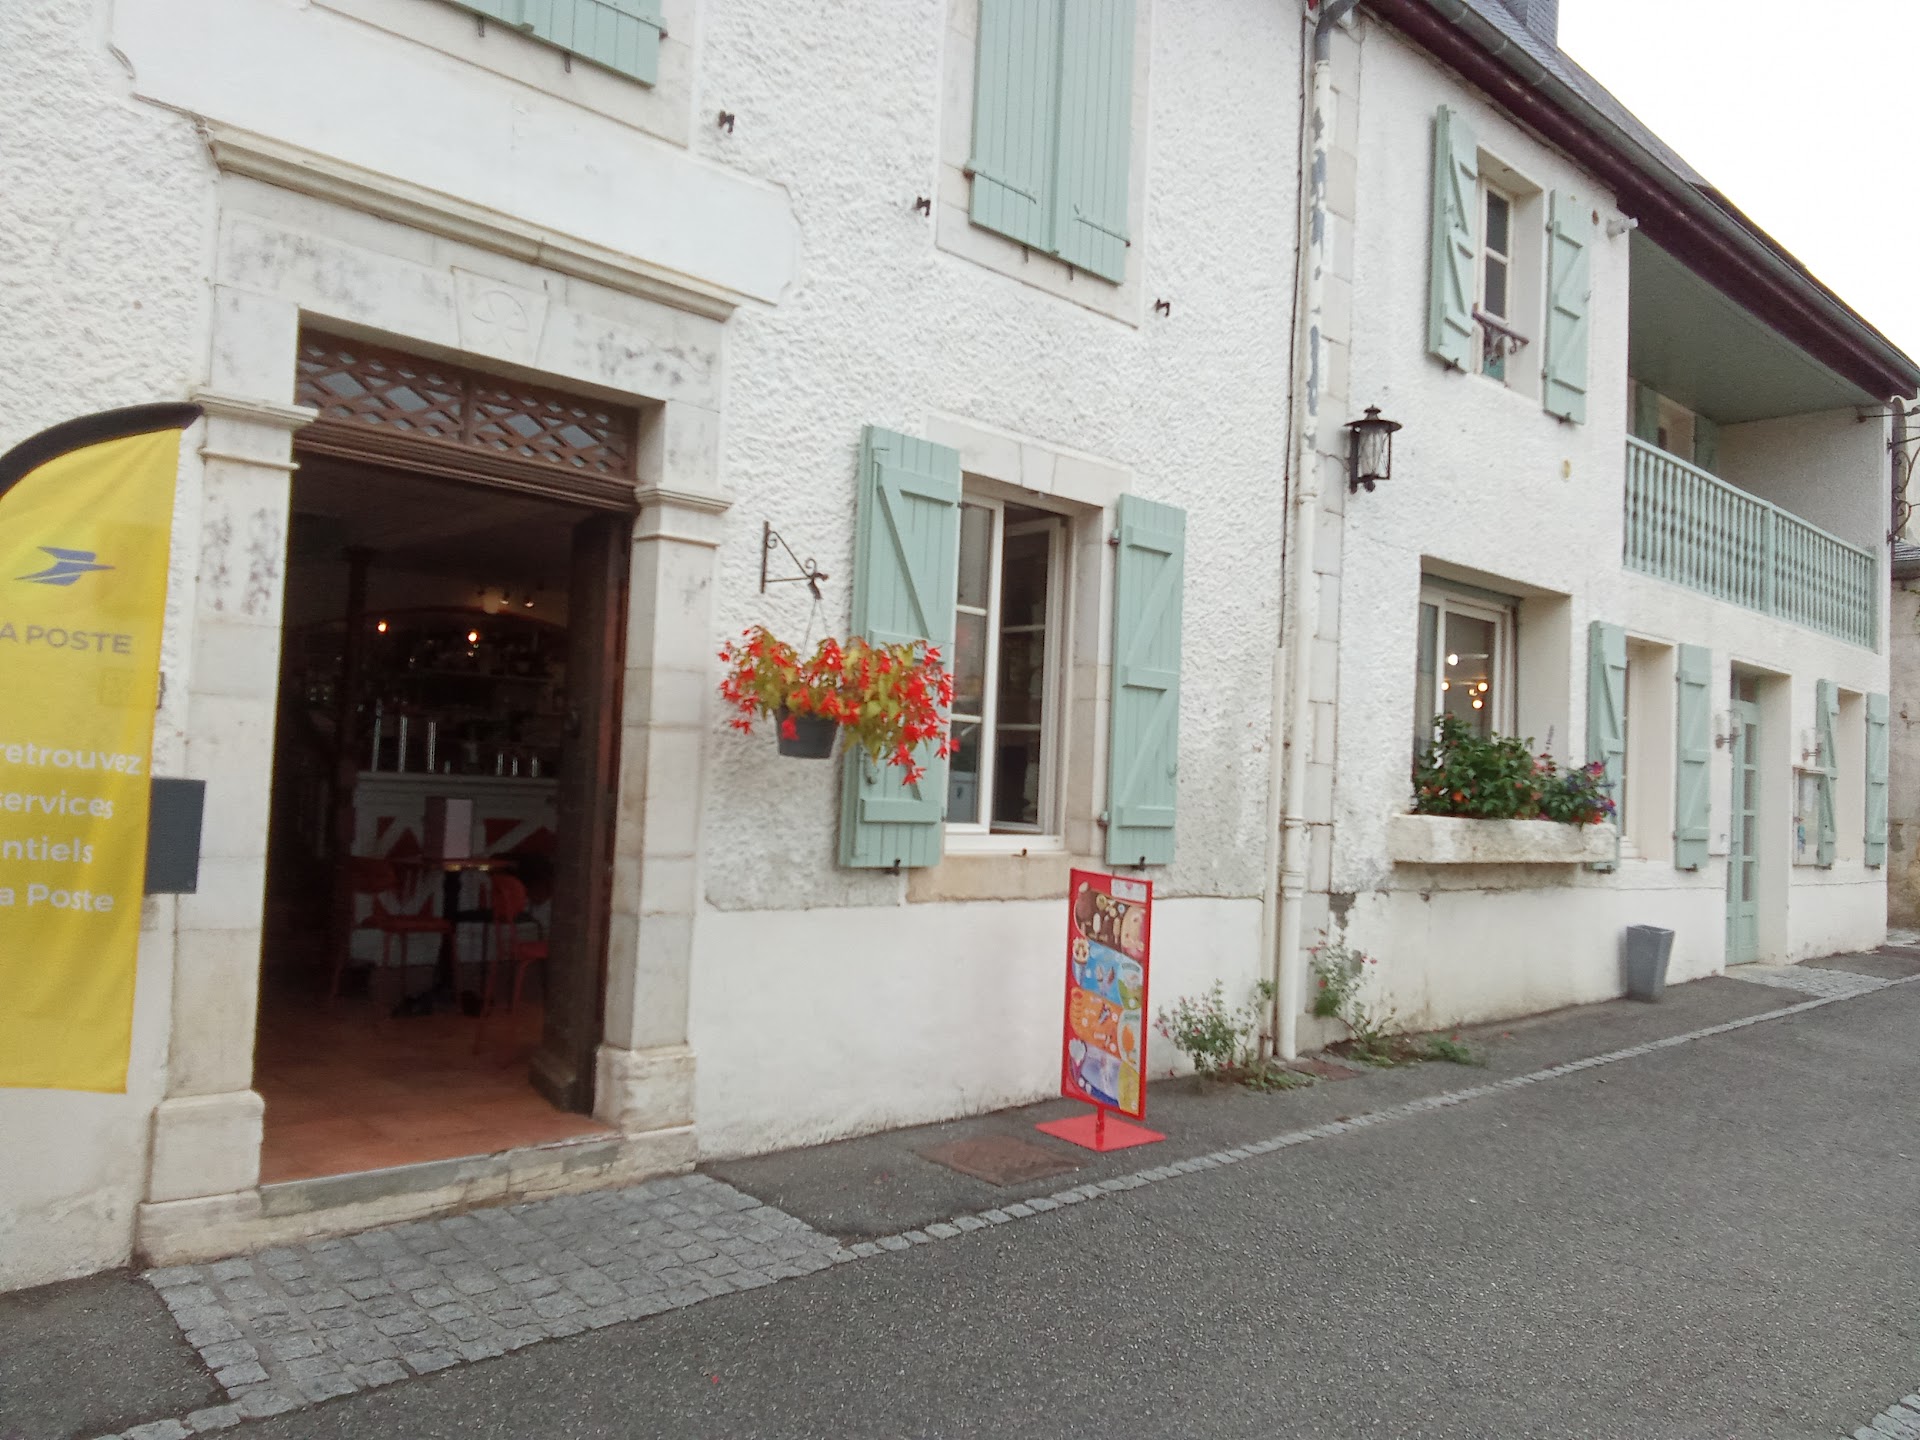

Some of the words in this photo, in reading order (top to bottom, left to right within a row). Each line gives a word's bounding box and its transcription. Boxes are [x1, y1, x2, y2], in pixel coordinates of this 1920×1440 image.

[26, 625, 133, 655] POSTE
[0, 790, 114, 819] ervices
[27, 883, 114, 912] Poste
